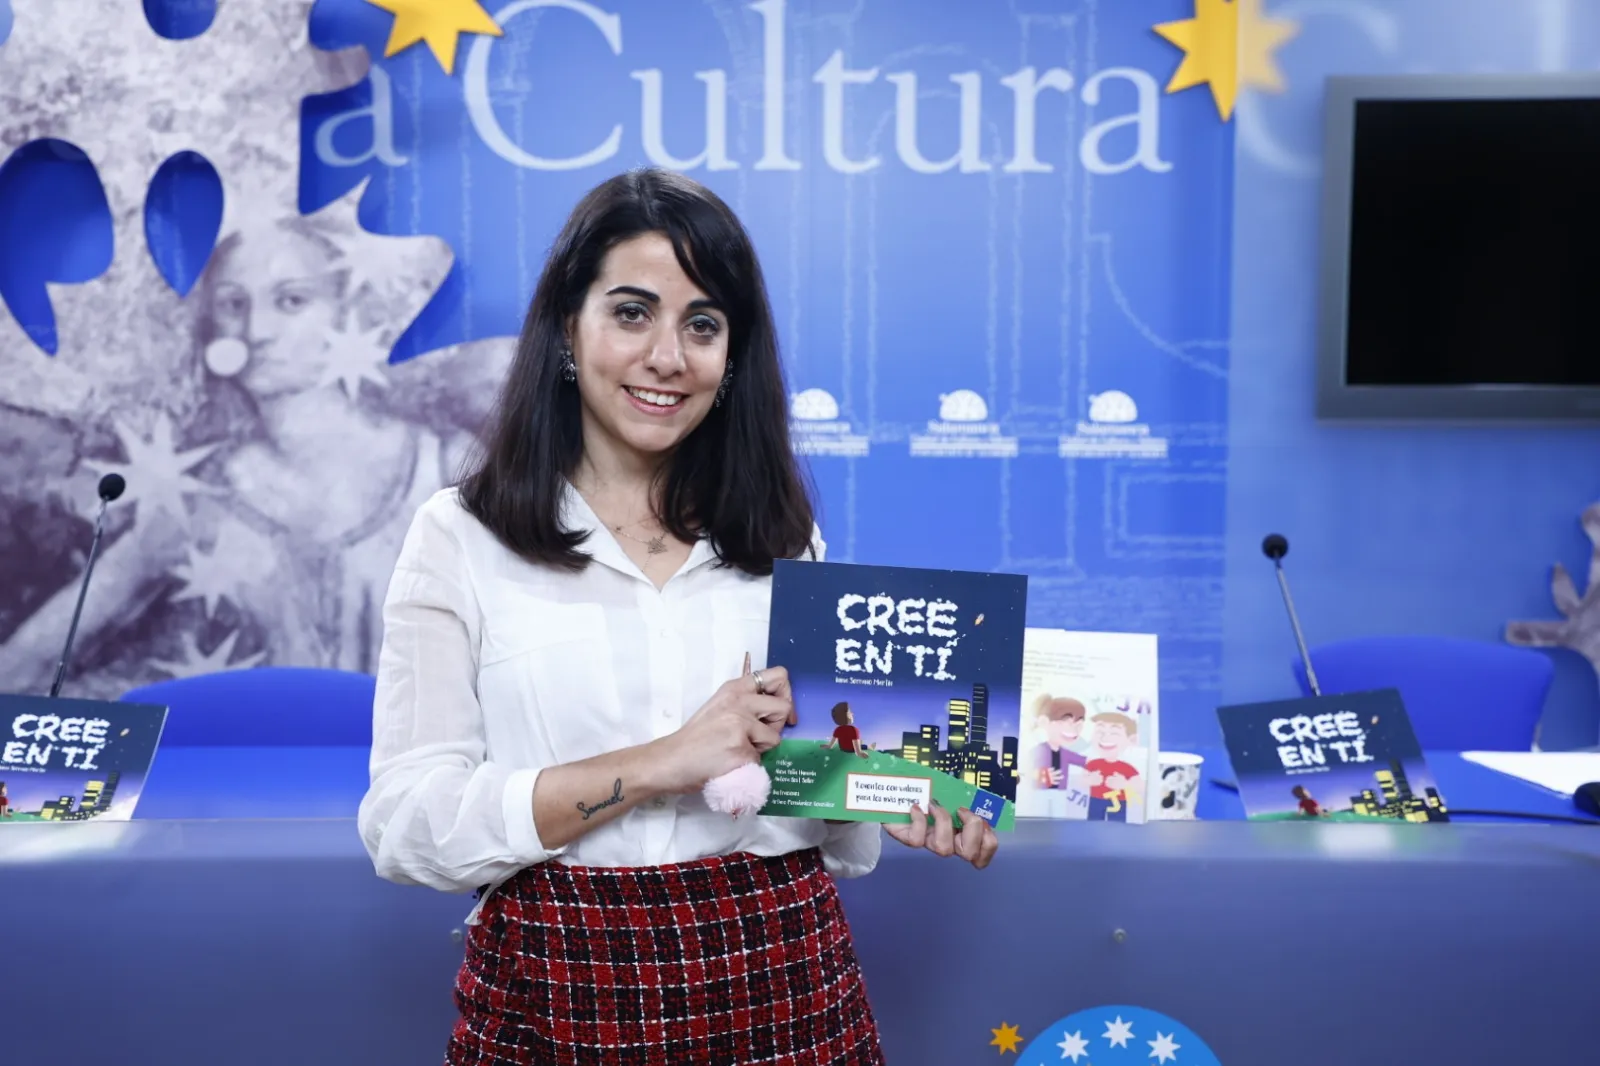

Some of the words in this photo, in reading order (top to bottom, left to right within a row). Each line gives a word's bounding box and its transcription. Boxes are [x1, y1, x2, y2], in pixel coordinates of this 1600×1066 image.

[462, 0, 1173, 174] Cultura
[836, 592, 958, 637] CREE
[835, 638, 893, 674] EN
[12, 713, 111, 743] CREE
[1269, 710, 1363, 743] CREE
[2, 741, 53, 765] EN
[1277, 742, 1326, 767] EN
[576, 777, 625, 820] Samuel
[855, 794, 871, 804] para
[872, 793, 882, 803] los
[885, 784, 898, 792] con
